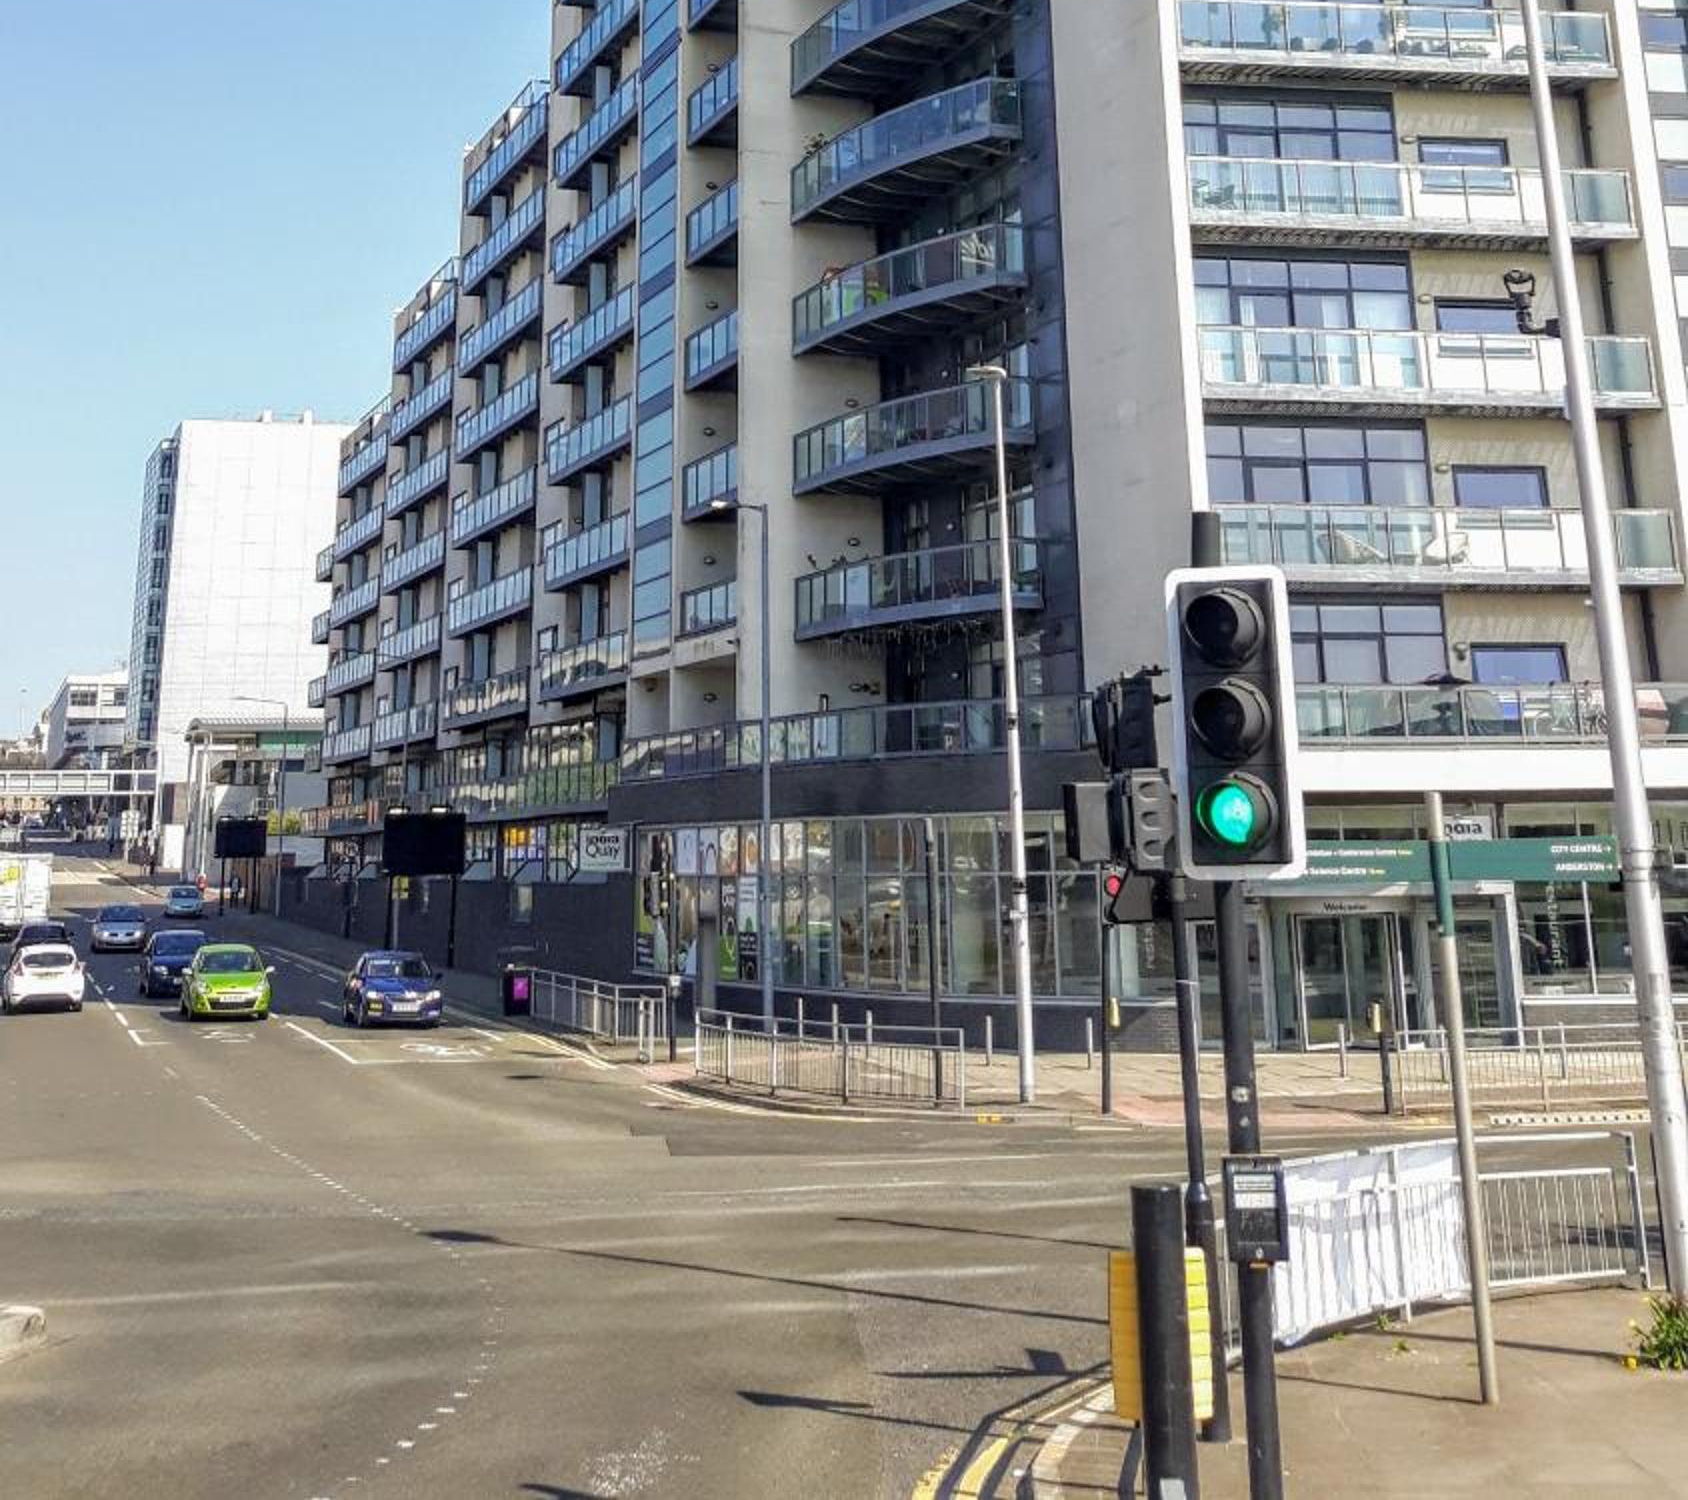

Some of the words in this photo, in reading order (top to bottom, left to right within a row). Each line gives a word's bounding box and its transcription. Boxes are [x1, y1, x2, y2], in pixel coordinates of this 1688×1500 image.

[1551, 845, 1569, 853] CITY
[1570, 844, 1603, 853] CENTRE
[1323, 901, 1368, 912] Welcome
